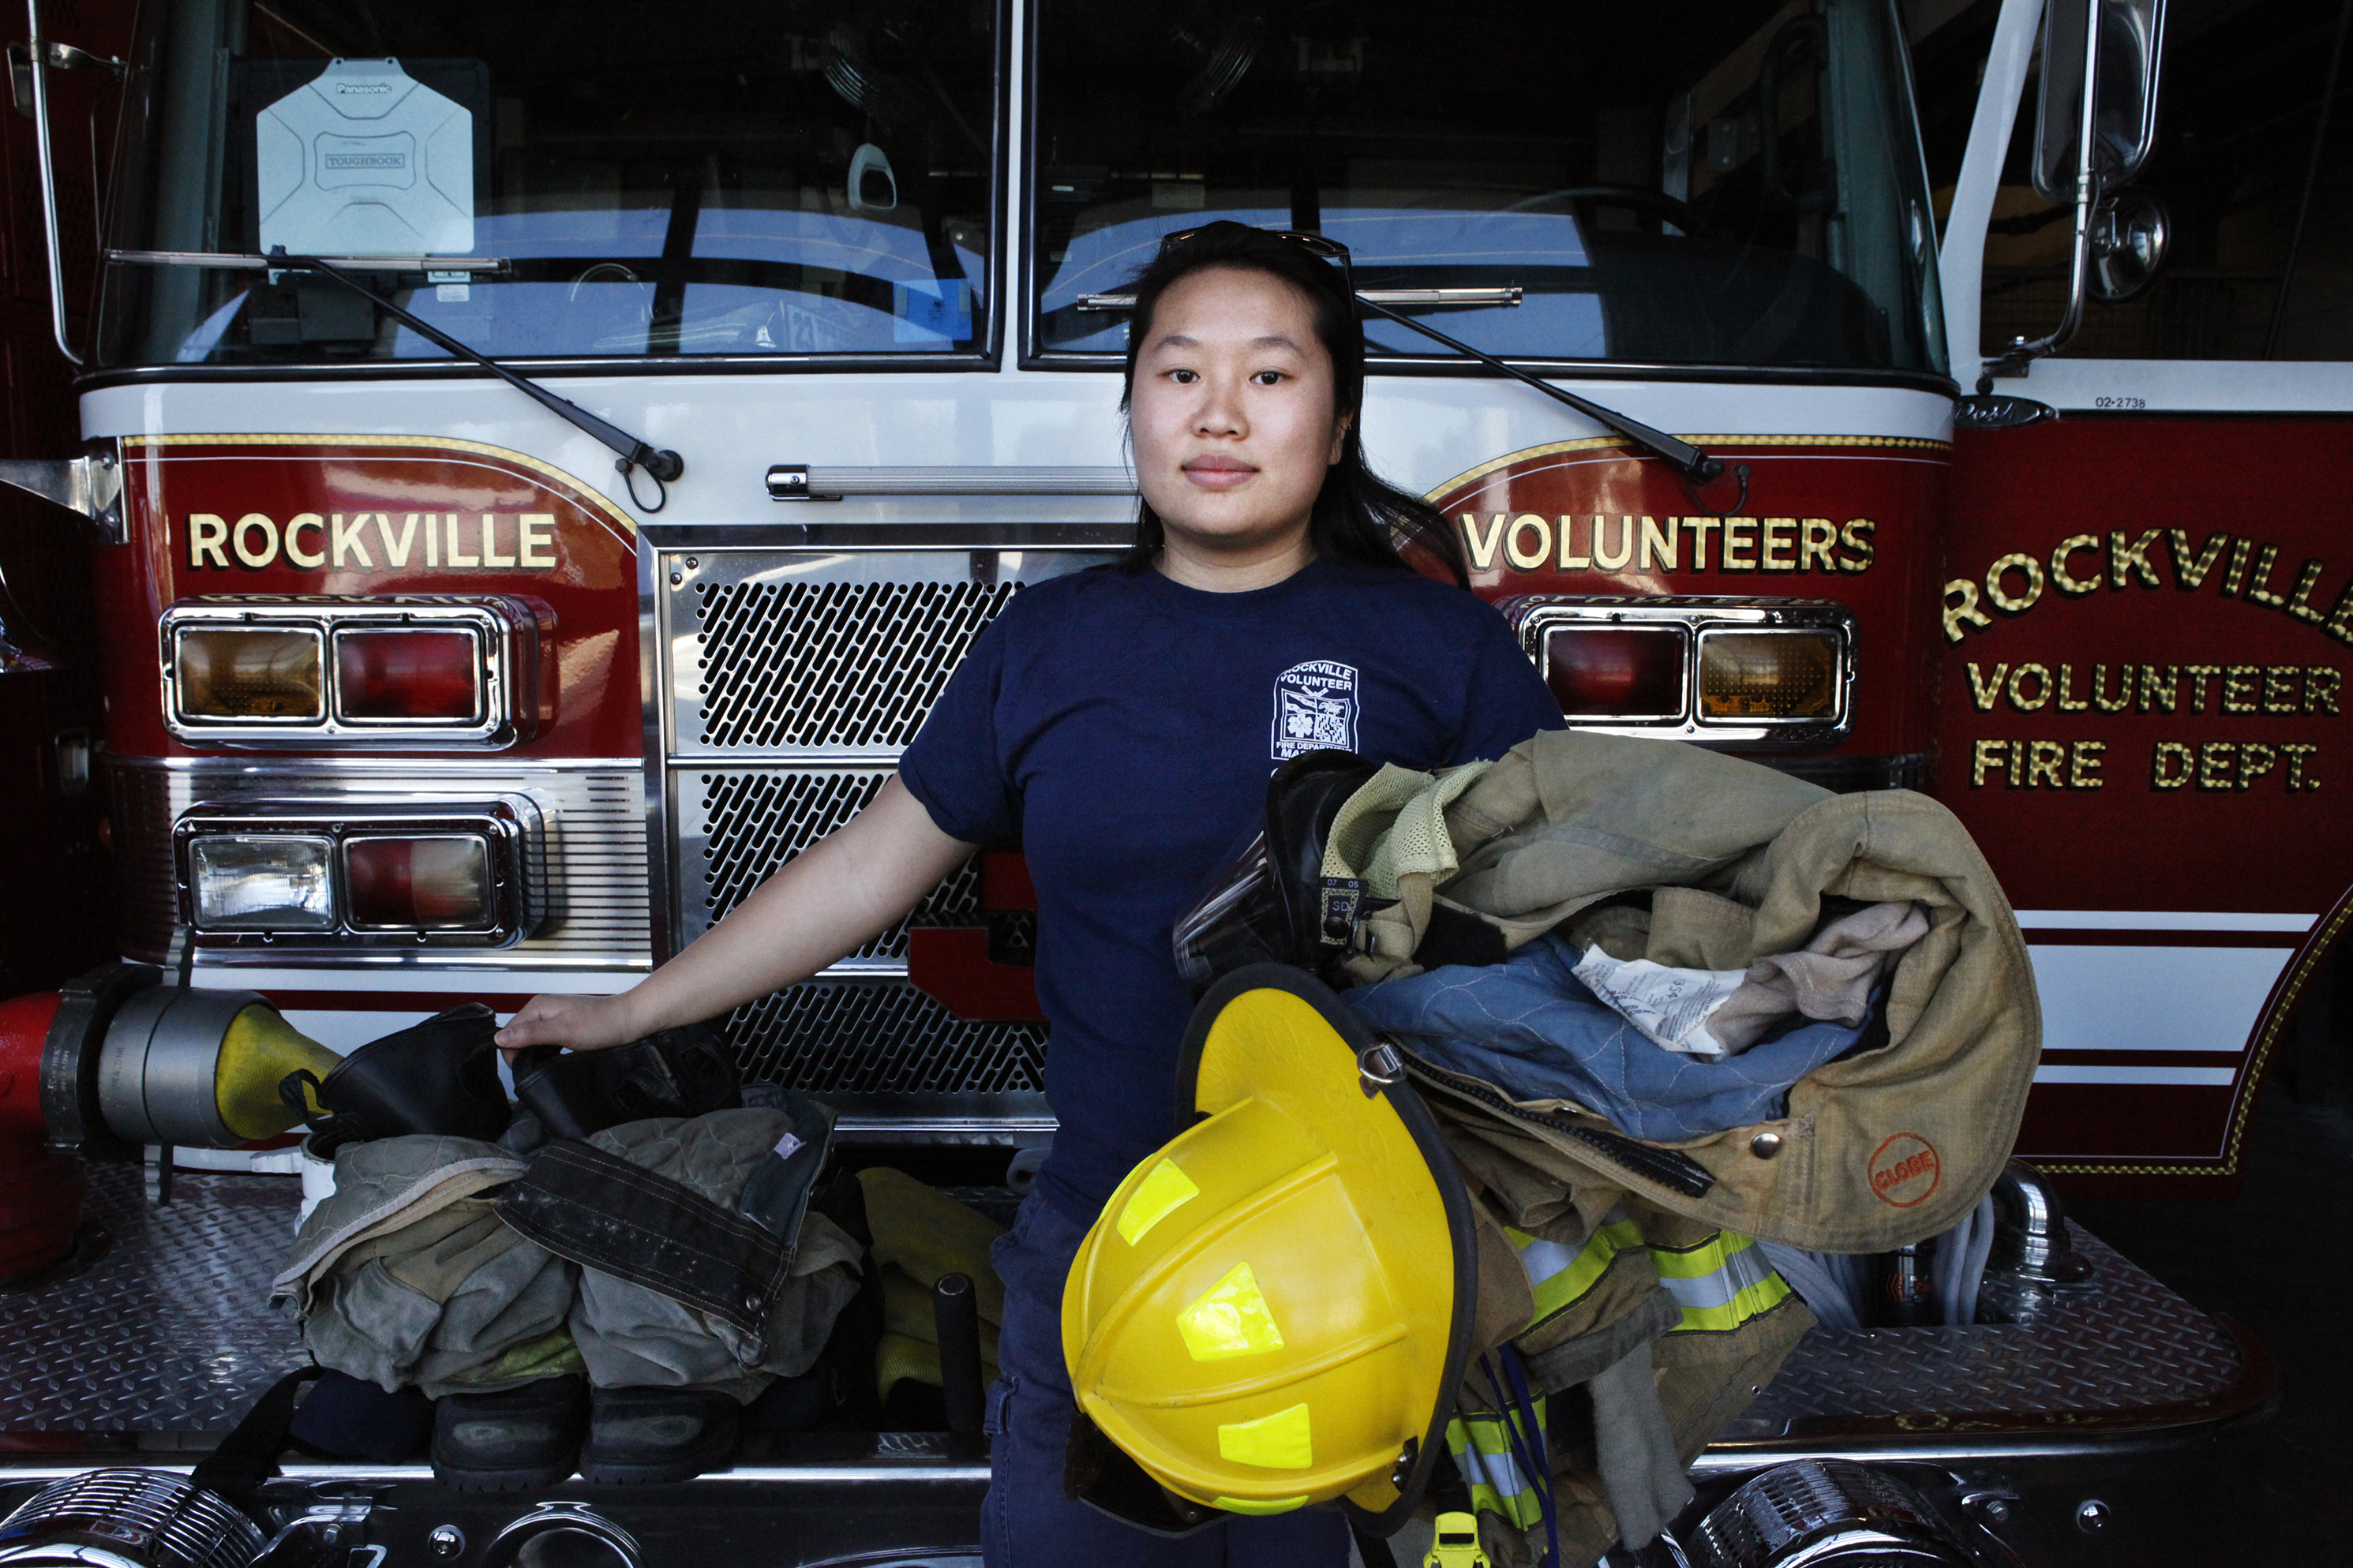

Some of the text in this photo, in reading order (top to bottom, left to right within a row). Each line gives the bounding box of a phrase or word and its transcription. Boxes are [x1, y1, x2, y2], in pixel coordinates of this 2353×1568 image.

[337, 83, 392, 94] Panasonic
[328, 157, 402, 166] TOUGHBOOK
[189, 513, 556, 568] ROCKVILLE
[1461, 514, 1876, 572] VOLUNTEERS
[1280, 674, 1353, 690] VOLUNTEER
[1966, 662, 2343, 713] VOLUNTEER
[1973, 739, 2321, 789] FIRE DEPT.
[1332, 901, 1349, 911] SD
[1875, 1150, 1935, 1190] GLOBE
